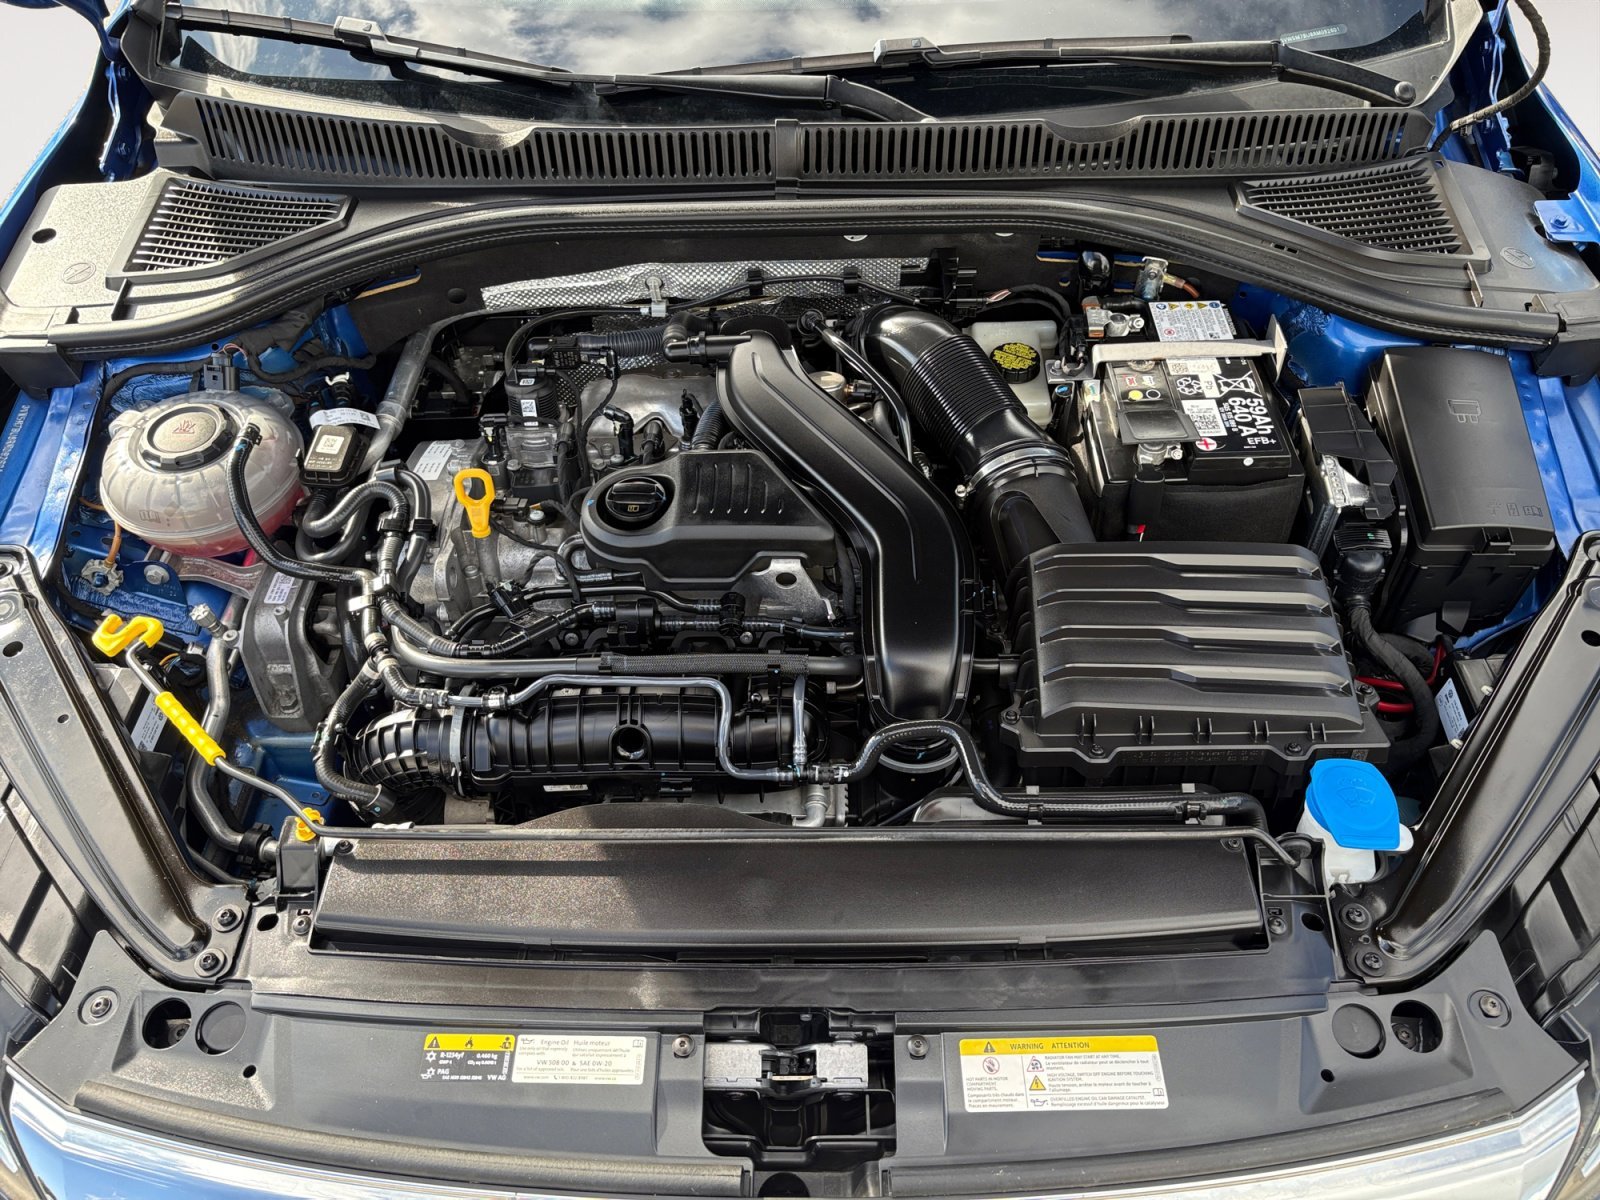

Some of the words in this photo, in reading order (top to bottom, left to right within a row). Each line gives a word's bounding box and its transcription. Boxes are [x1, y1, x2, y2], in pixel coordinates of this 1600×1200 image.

[1228, 397, 1252, 422] 640
[1246, 398, 1274, 434] 59Ah
[1238, 425, 1258, 436] A
[1247, 436, 1276, 445] EFB+
